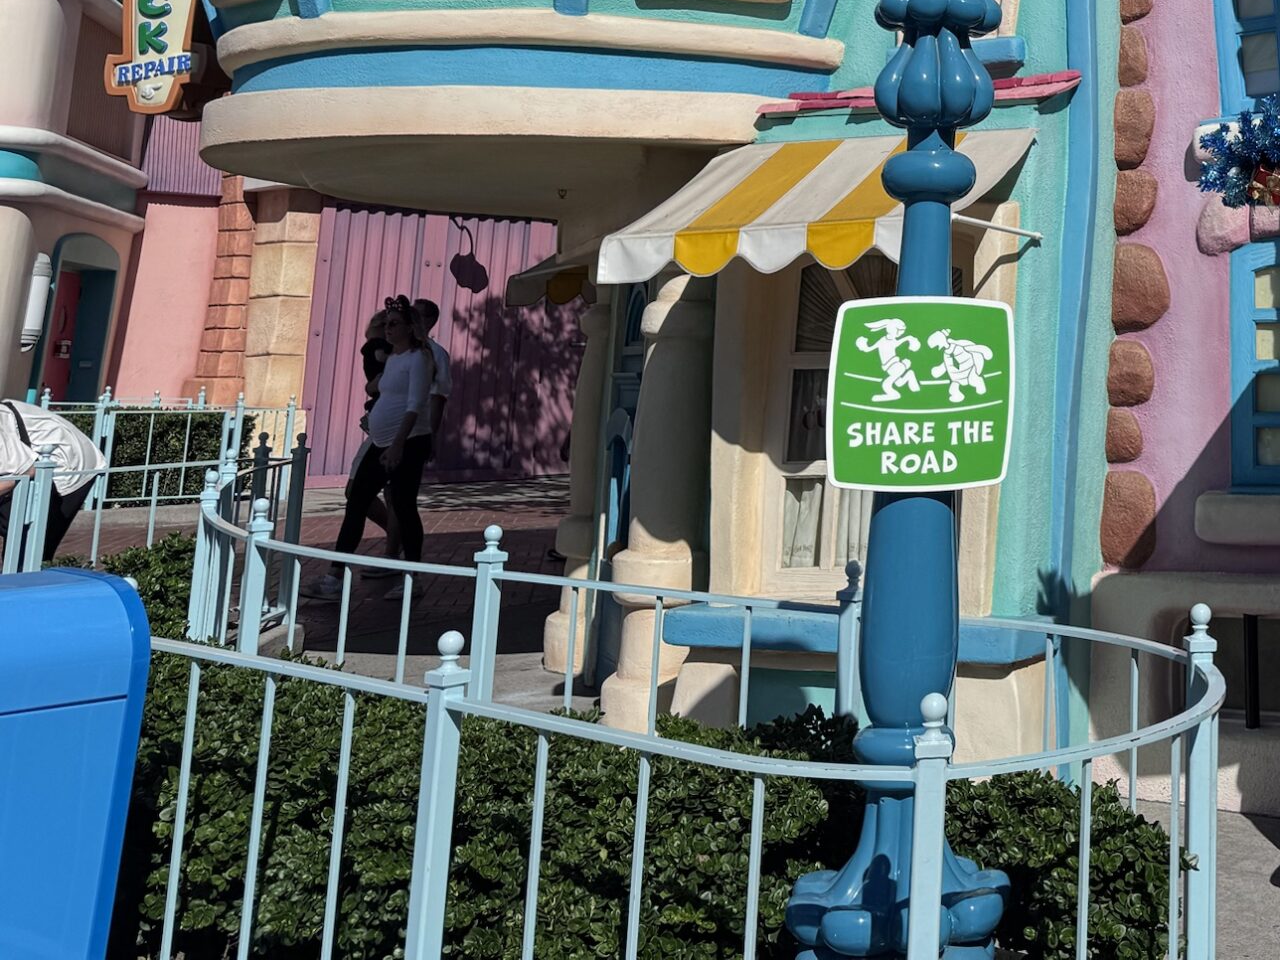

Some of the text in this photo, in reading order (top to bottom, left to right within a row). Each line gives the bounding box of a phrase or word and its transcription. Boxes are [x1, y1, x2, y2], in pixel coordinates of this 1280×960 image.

[116, 55, 191, 85] REPAIR
[846, 420, 994, 447] SHARE THE
[881, 450, 958, 474] ROAD
